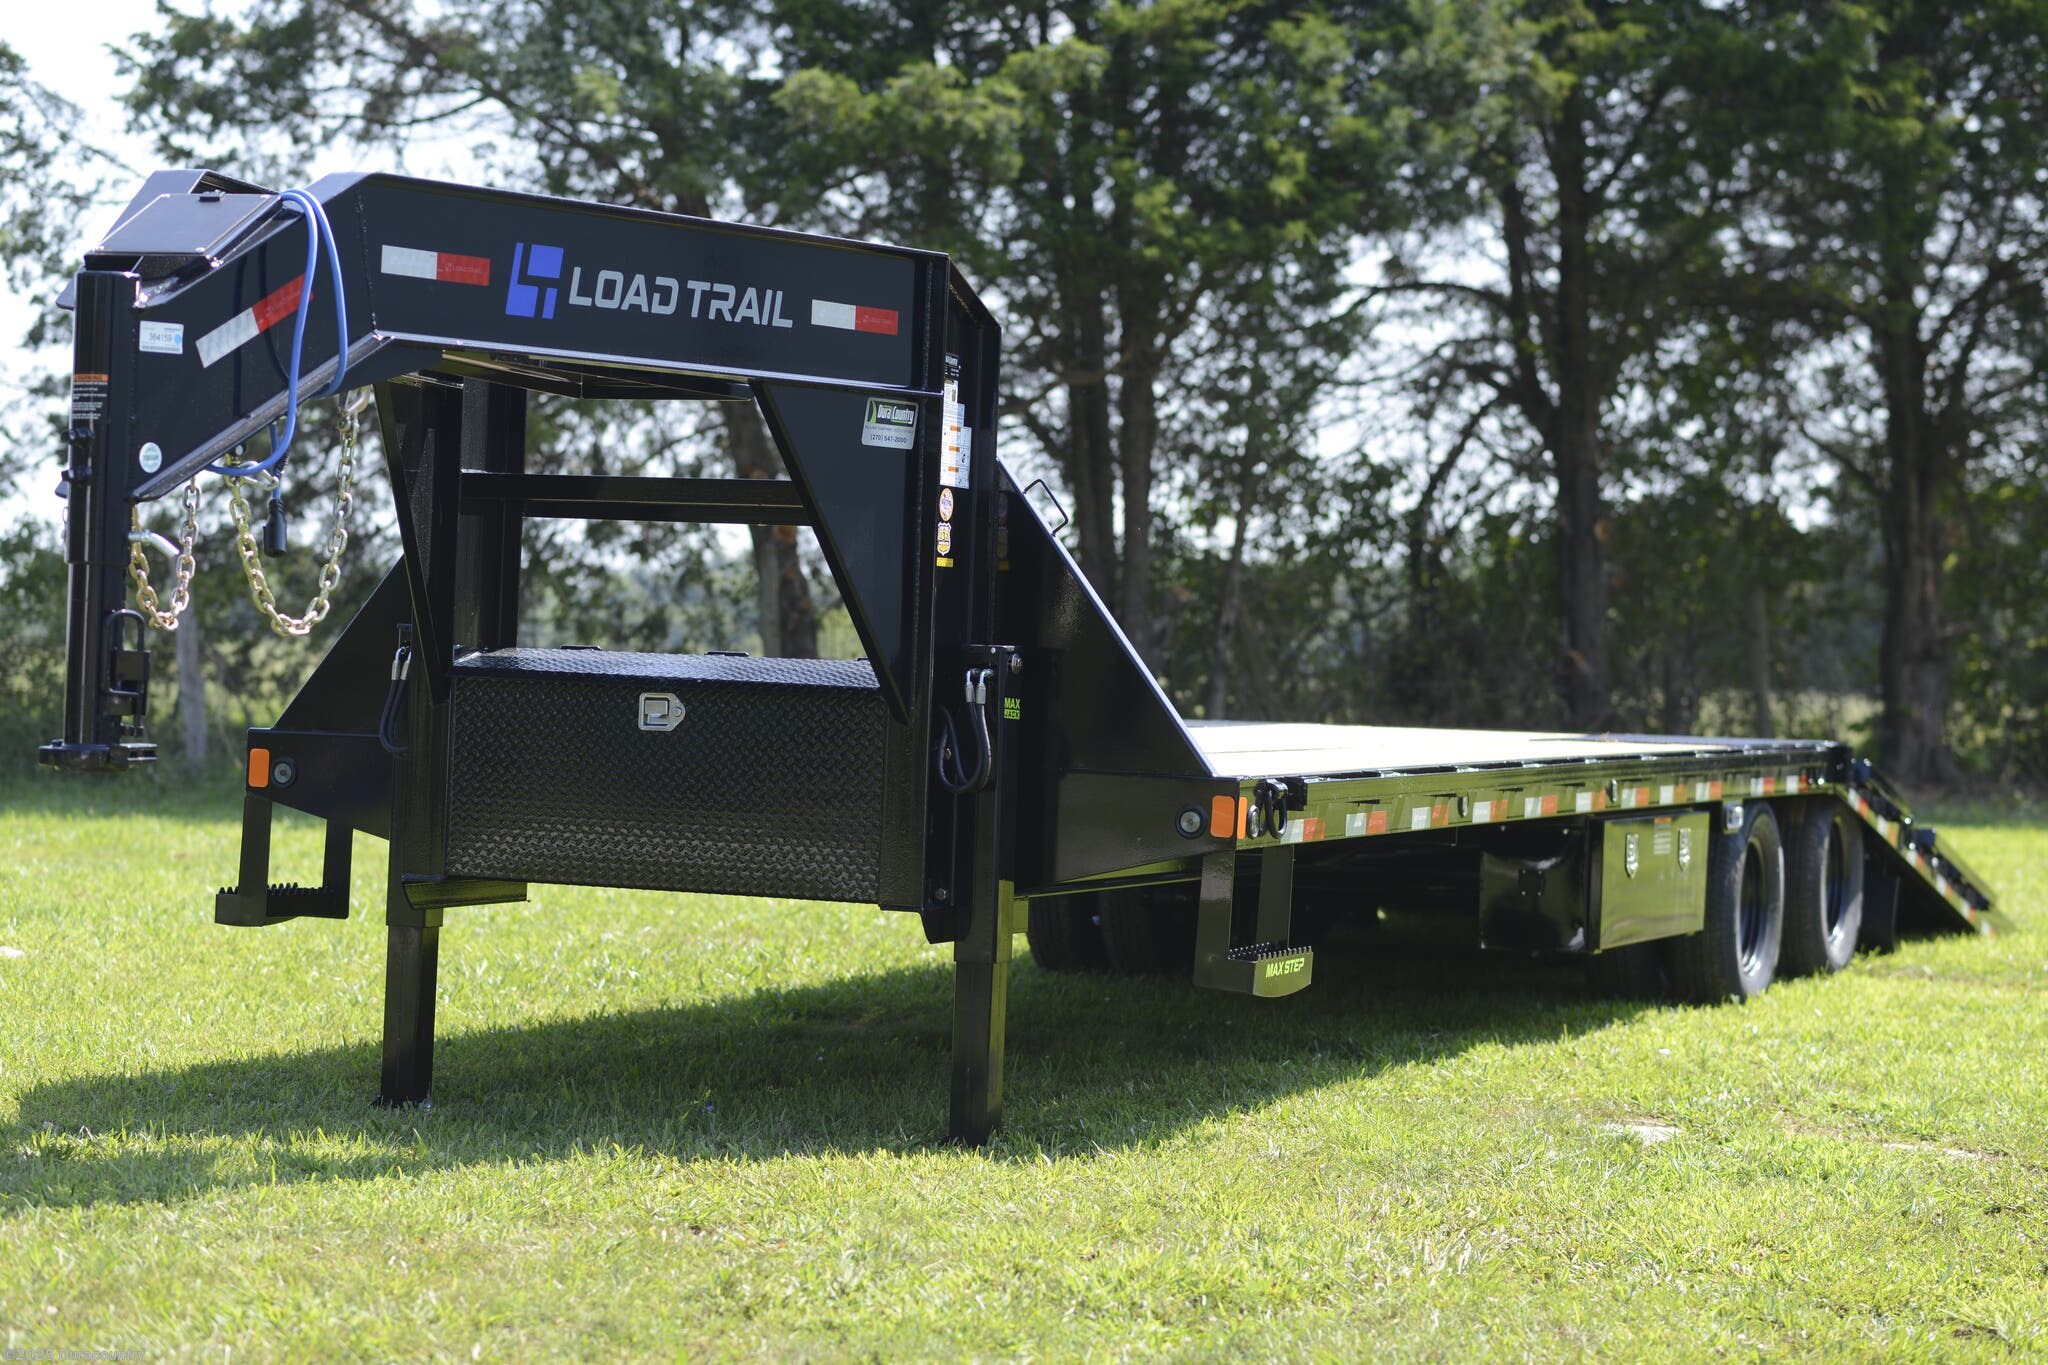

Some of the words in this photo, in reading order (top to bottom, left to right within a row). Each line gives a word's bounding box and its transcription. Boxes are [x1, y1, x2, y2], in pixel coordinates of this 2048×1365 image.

[568, 266, 679, 315] LOAD
[686, 279, 793, 329] TRAIL
[877, 404, 891, 419] Dura
[892, 406, 914, 424] Country
[871, 433, 884, 442] (270)
[1004, 697, 1020, 709] MAX
[1265, 961, 1284, 978] MAX
[1284, 958, 1304, 974] STEP
